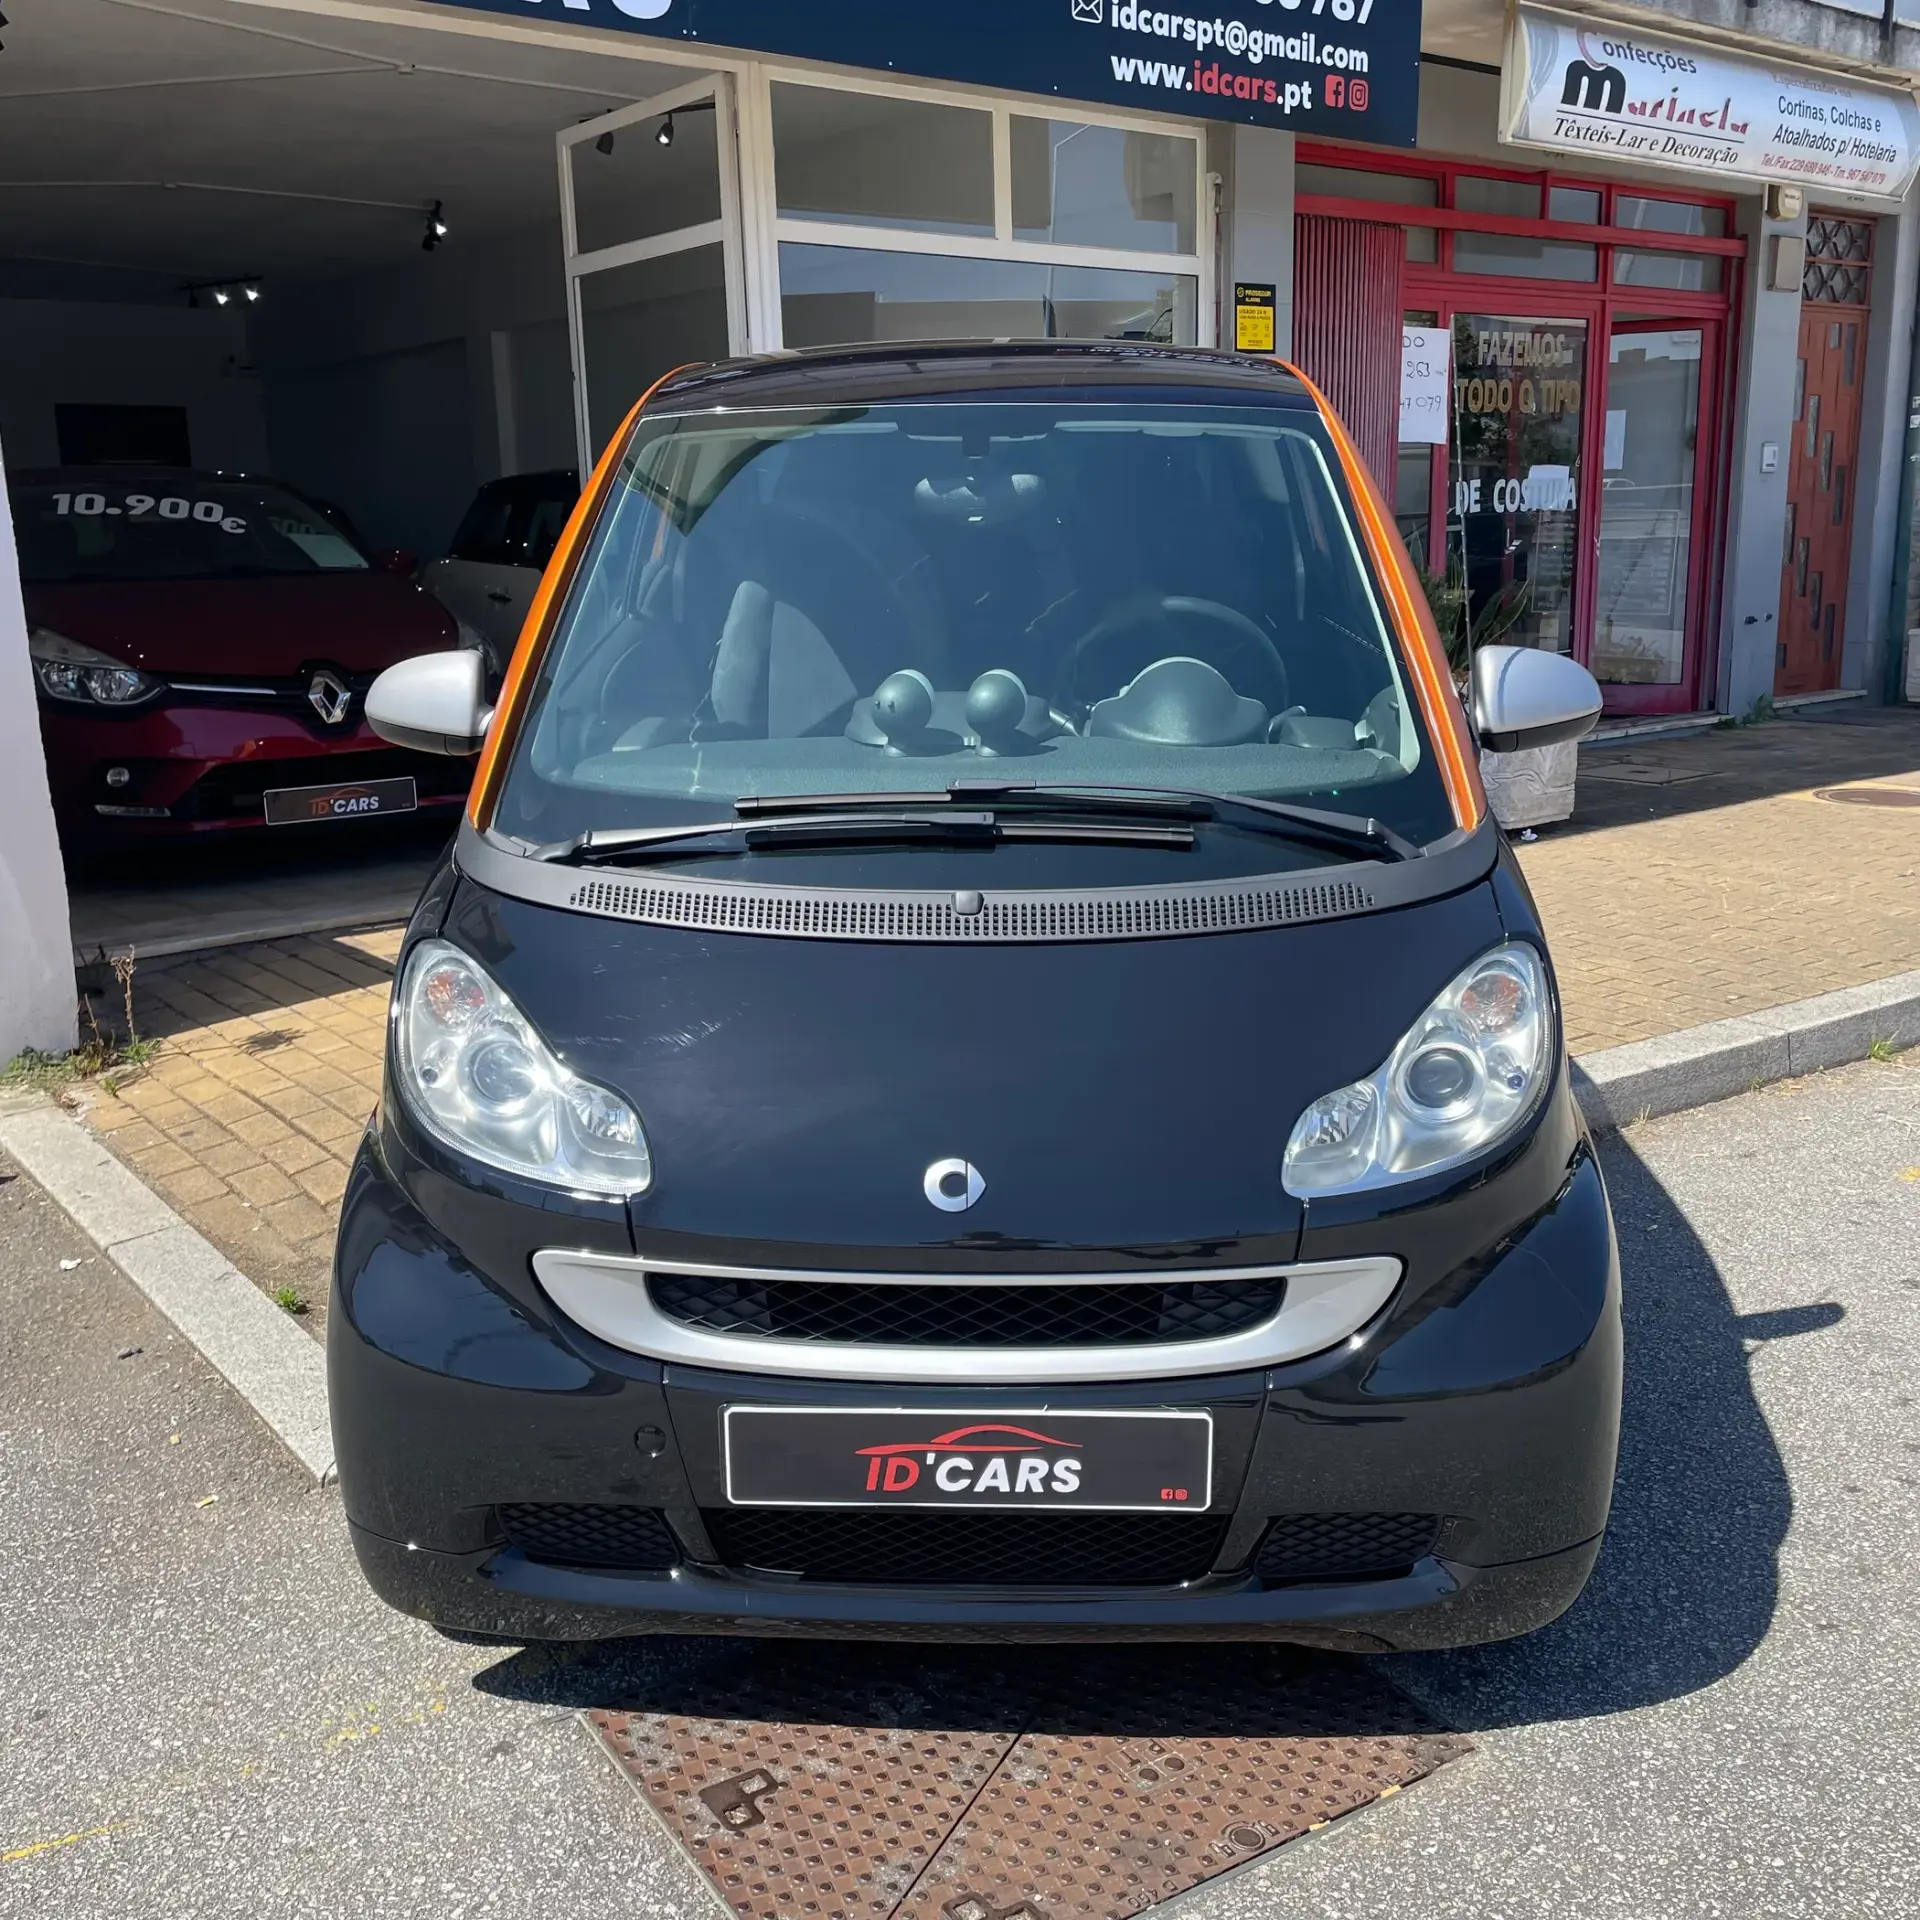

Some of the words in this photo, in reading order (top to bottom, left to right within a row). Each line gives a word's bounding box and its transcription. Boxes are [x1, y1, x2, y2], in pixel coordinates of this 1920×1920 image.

[1111, 0, 1369, 73] idcarspt@gmail.com
[1110, 55, 1312, 114] www.idcars.pt
[1778, 95, 1827, 125] Cortinas,
[1831, 106, 1873, 131] Colchas
[1875, 119, 1882, 133] e
[1553, 117, 1649, 149] Têxteis-Lar
[1649, 138, 1659, 151] e
[1660, 135, 1739, 166] Decoração
[1772, 124, 1837, 154] Atoalhados
[1835, 136, 1851, 158] p/
[1850, 137, 1897, 163] Hotelaria
[1478, 331, 1566, 367] FAZEMOS
[1457, 378, 1513, 413] TODO
[1540, 379, 1580, 413] TIPO
[52, 493, 247, 534] 10.900€
[1455, 479, 1481, 515] DE
[311, 796, 380, 815] ID'CARS
[865, 1452, 1084, 1493] ID'CARS
